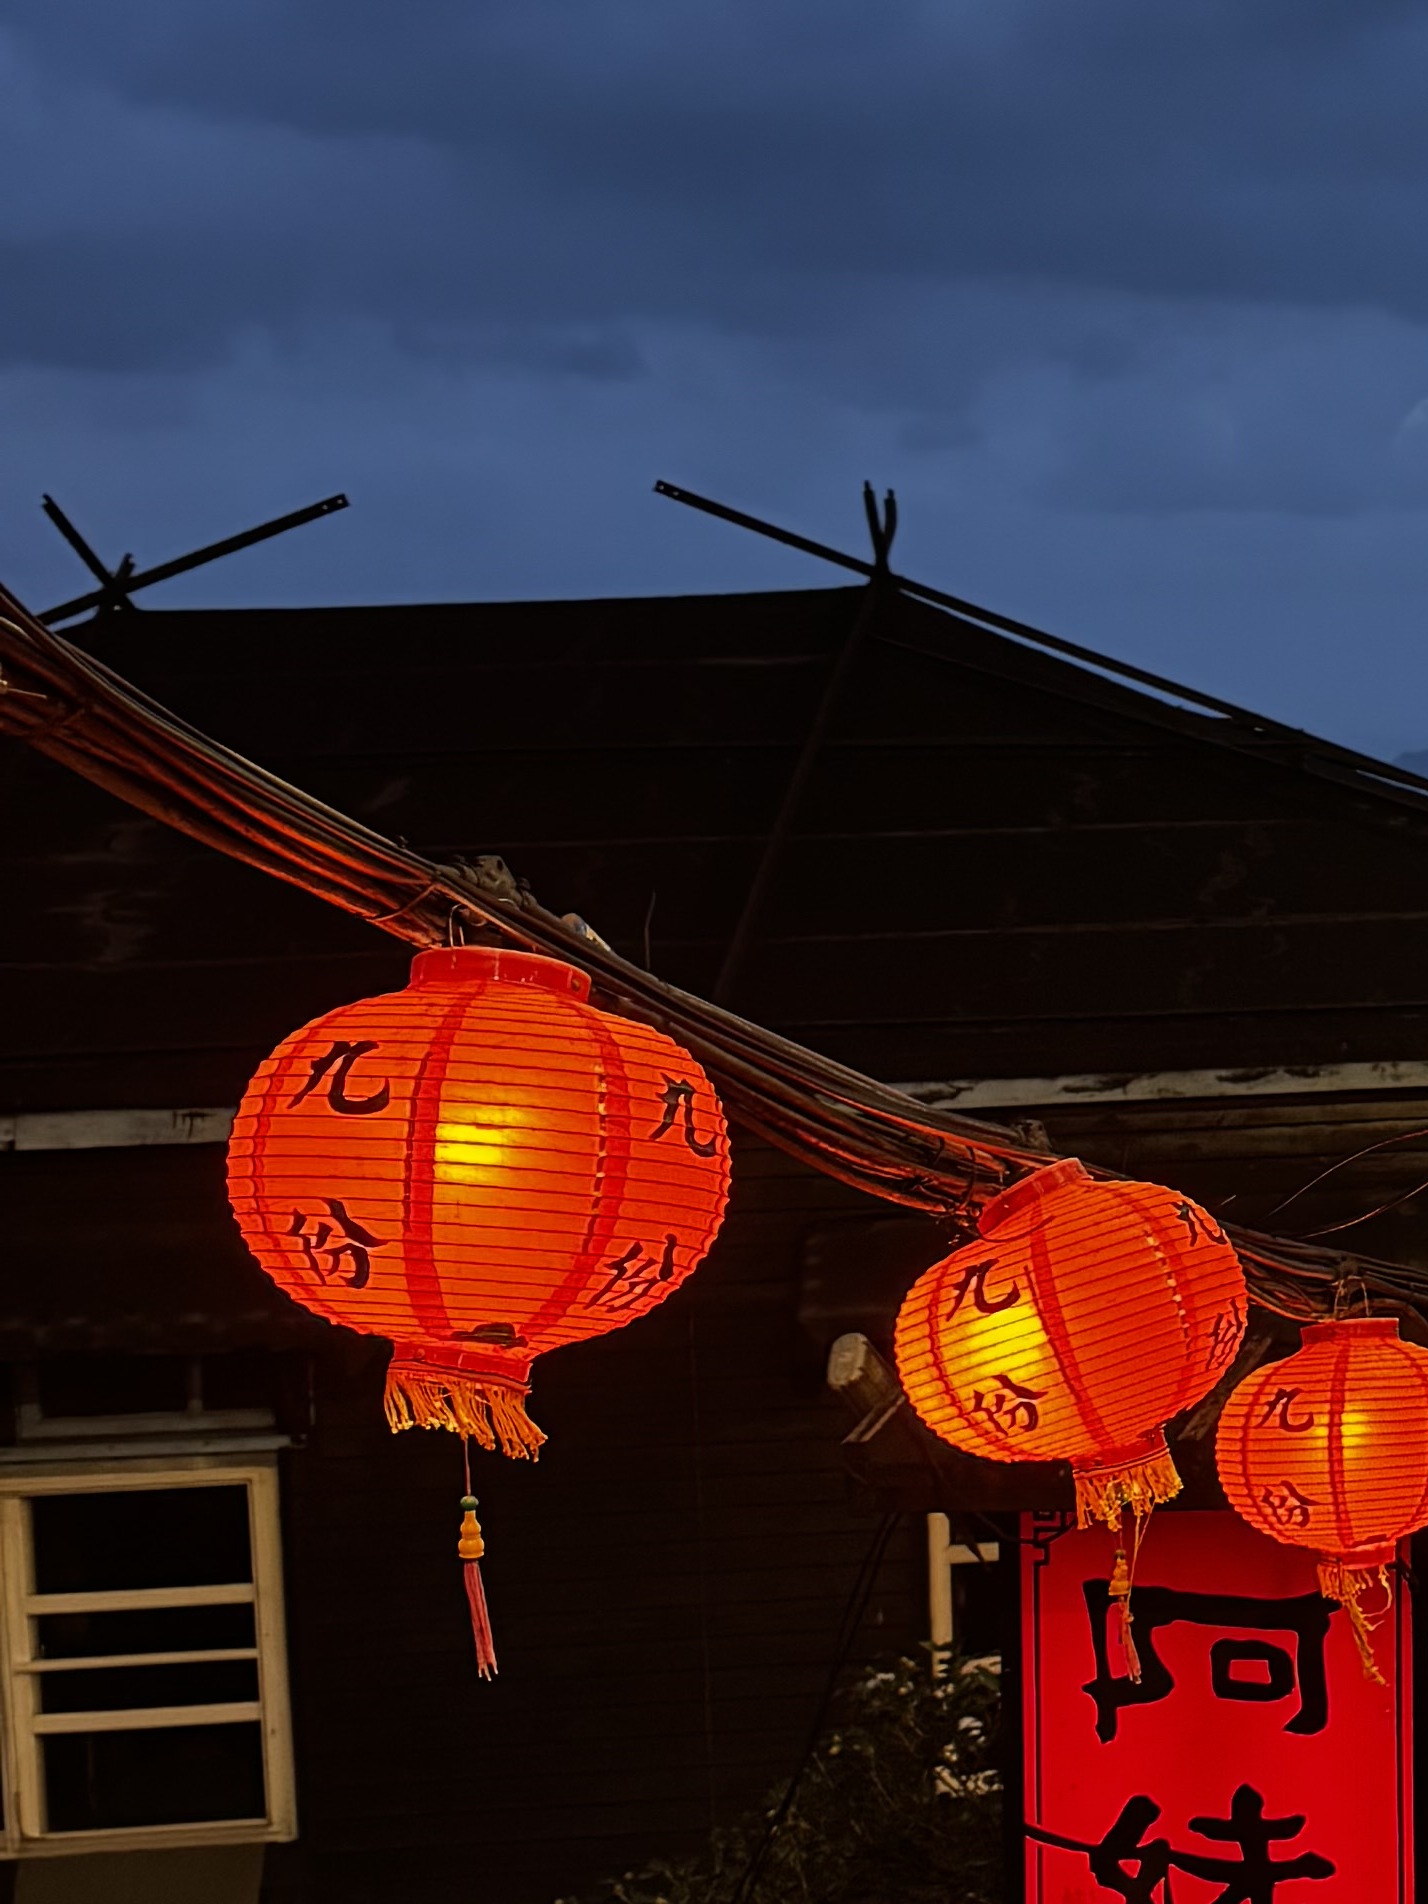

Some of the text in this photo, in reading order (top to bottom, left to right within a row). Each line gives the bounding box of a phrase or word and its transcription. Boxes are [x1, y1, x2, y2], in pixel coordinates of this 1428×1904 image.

[287, 1040, 392, 1289] 九份
[584, 1073, 718, 1312] 九份
[946, 1258, 1048, 1437] 九份
[1256, 1388, 1322, 1528] 九份
